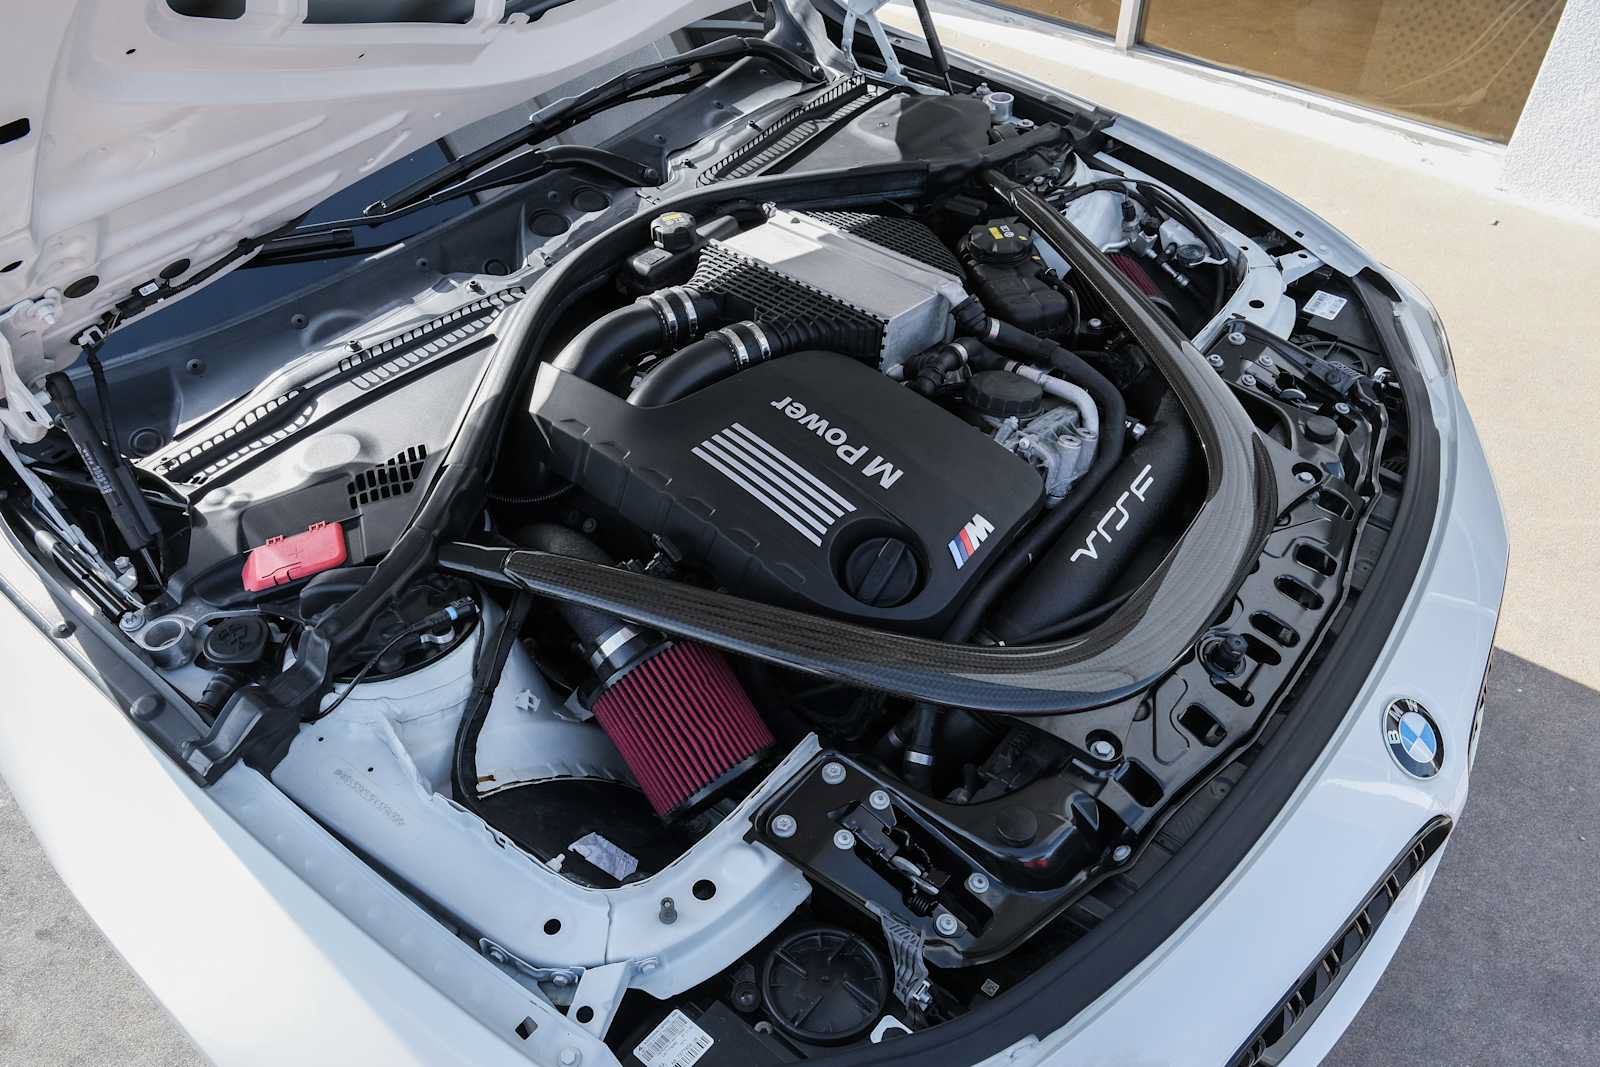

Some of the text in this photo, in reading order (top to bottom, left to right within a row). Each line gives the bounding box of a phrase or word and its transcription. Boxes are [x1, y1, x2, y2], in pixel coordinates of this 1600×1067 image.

[770, 396, 904, 490] M Power
[1387, 699, 1419, 745] BMW
